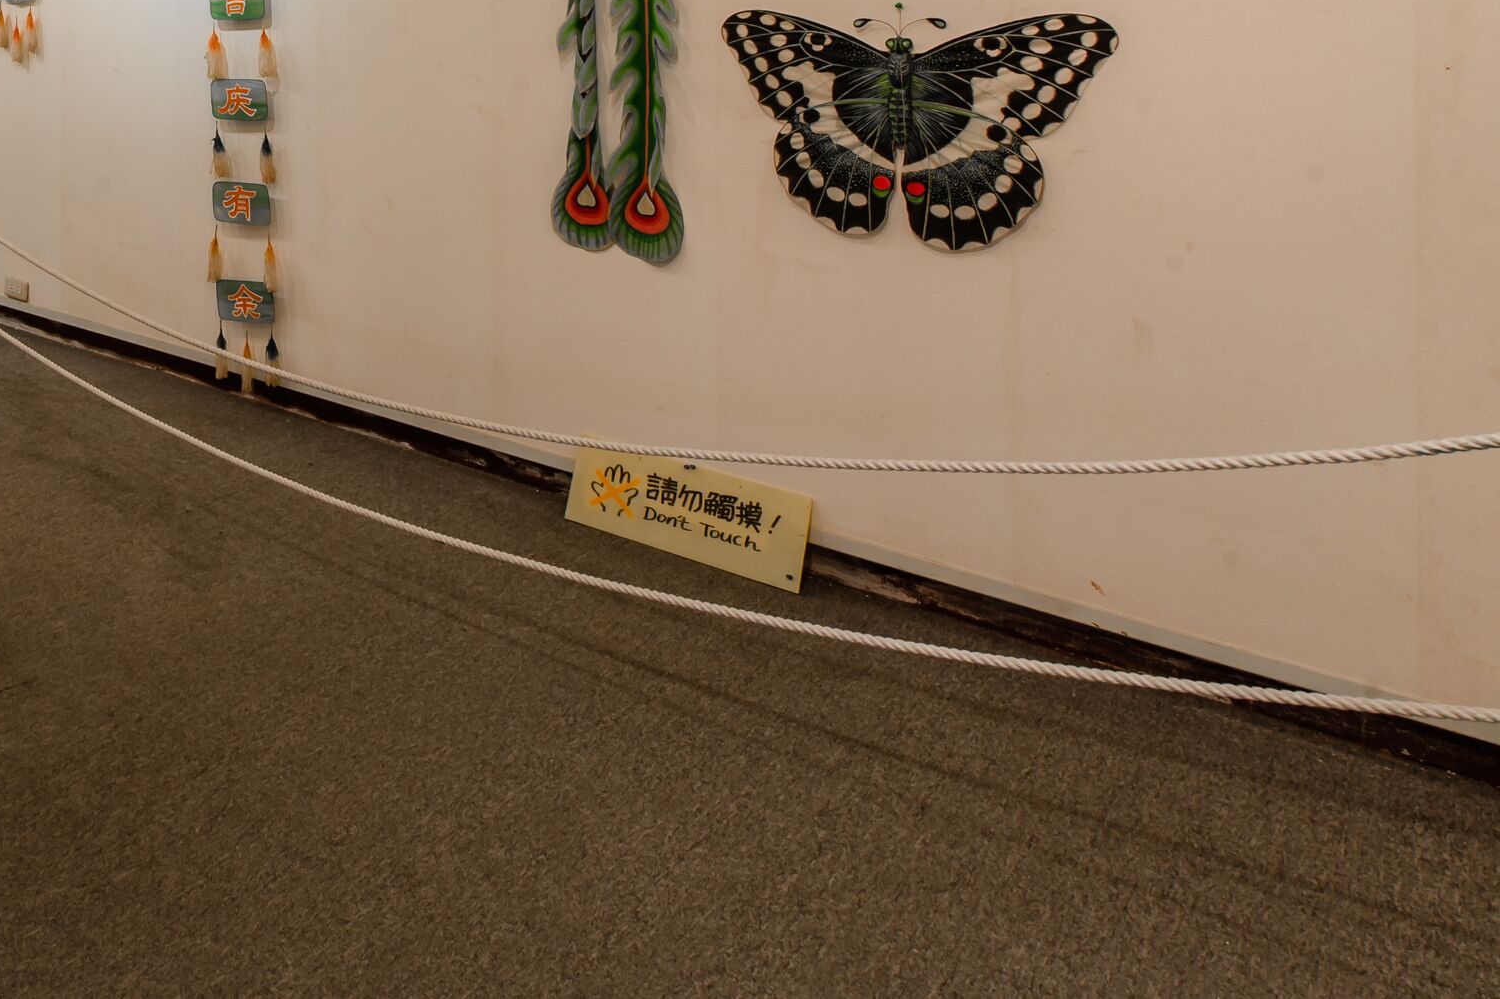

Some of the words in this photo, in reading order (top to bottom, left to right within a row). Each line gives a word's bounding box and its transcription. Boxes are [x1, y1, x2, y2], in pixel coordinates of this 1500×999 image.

[218, 83, 257, 117] 庆
[222, 185, 257, 222] 有
[228, 283, 263, 319] 余
[645, 472, 782, 535] 請勿觸摸！
[643, 506, 693, 532] Don't
[699, 521, 762, 552] Touch
